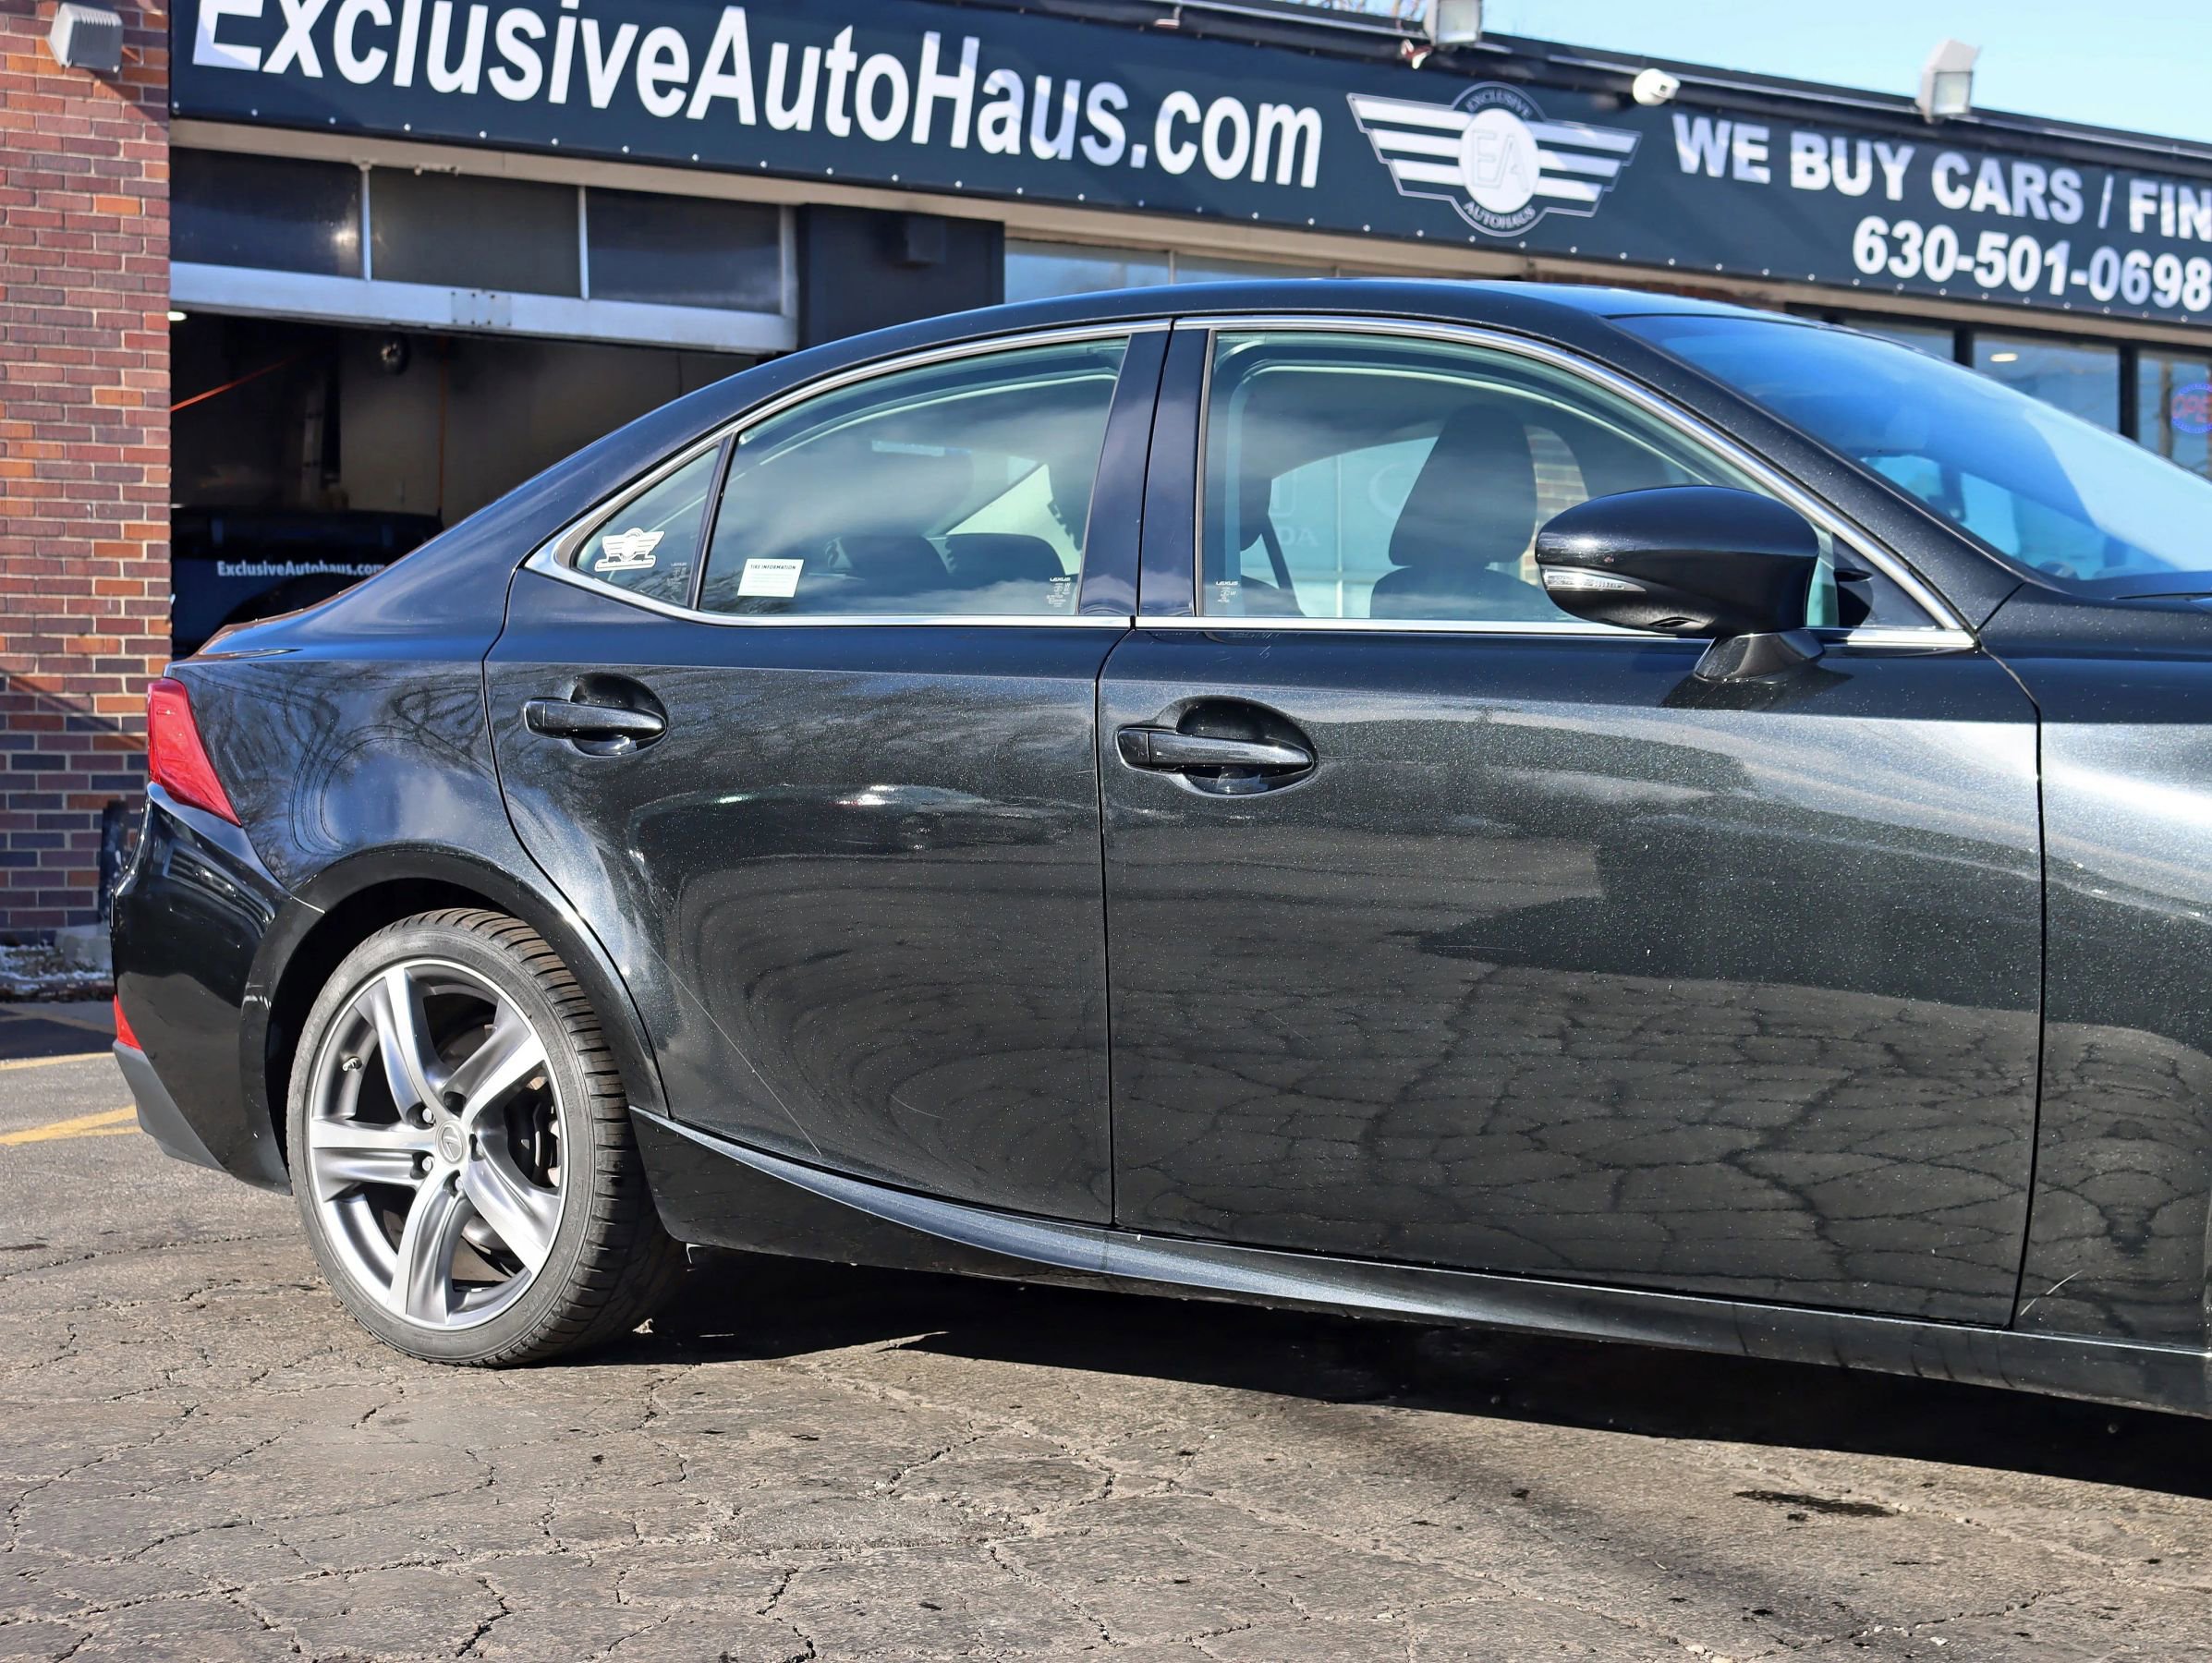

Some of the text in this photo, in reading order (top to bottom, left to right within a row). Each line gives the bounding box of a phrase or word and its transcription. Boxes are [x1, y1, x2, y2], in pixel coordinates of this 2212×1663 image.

[192, 0, 1322, 189] ExclusiveAutoHaus.com
[1465, 89, 1533, 119] EXCLUSIVE
[1472, 129, 1530, 193] EA
[1671, 113, 2212, 242] WE BUY CARS / FIN
[1464, 201, 1537, 230] AUTOHAUS
[1853, 215, 2212, 312] 630-501-0698
